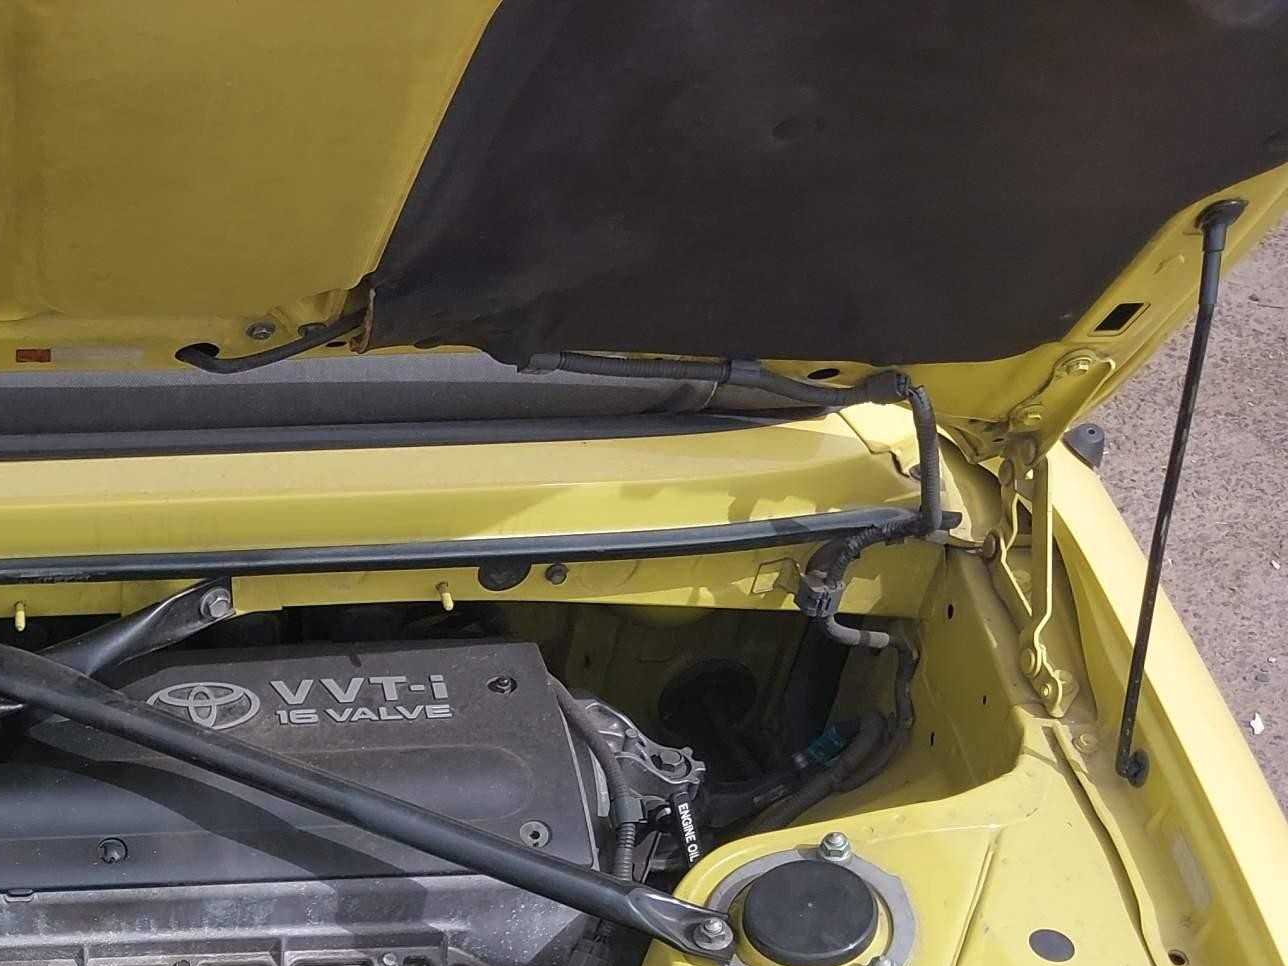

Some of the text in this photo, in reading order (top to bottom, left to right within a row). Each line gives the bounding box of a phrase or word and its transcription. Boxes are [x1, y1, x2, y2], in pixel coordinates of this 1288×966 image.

[269, 674, 450, 706] VVT-i
[275, 703, 453, 725] 16 VALVE
[678, 803, 700, 863] ENGINE OIL
